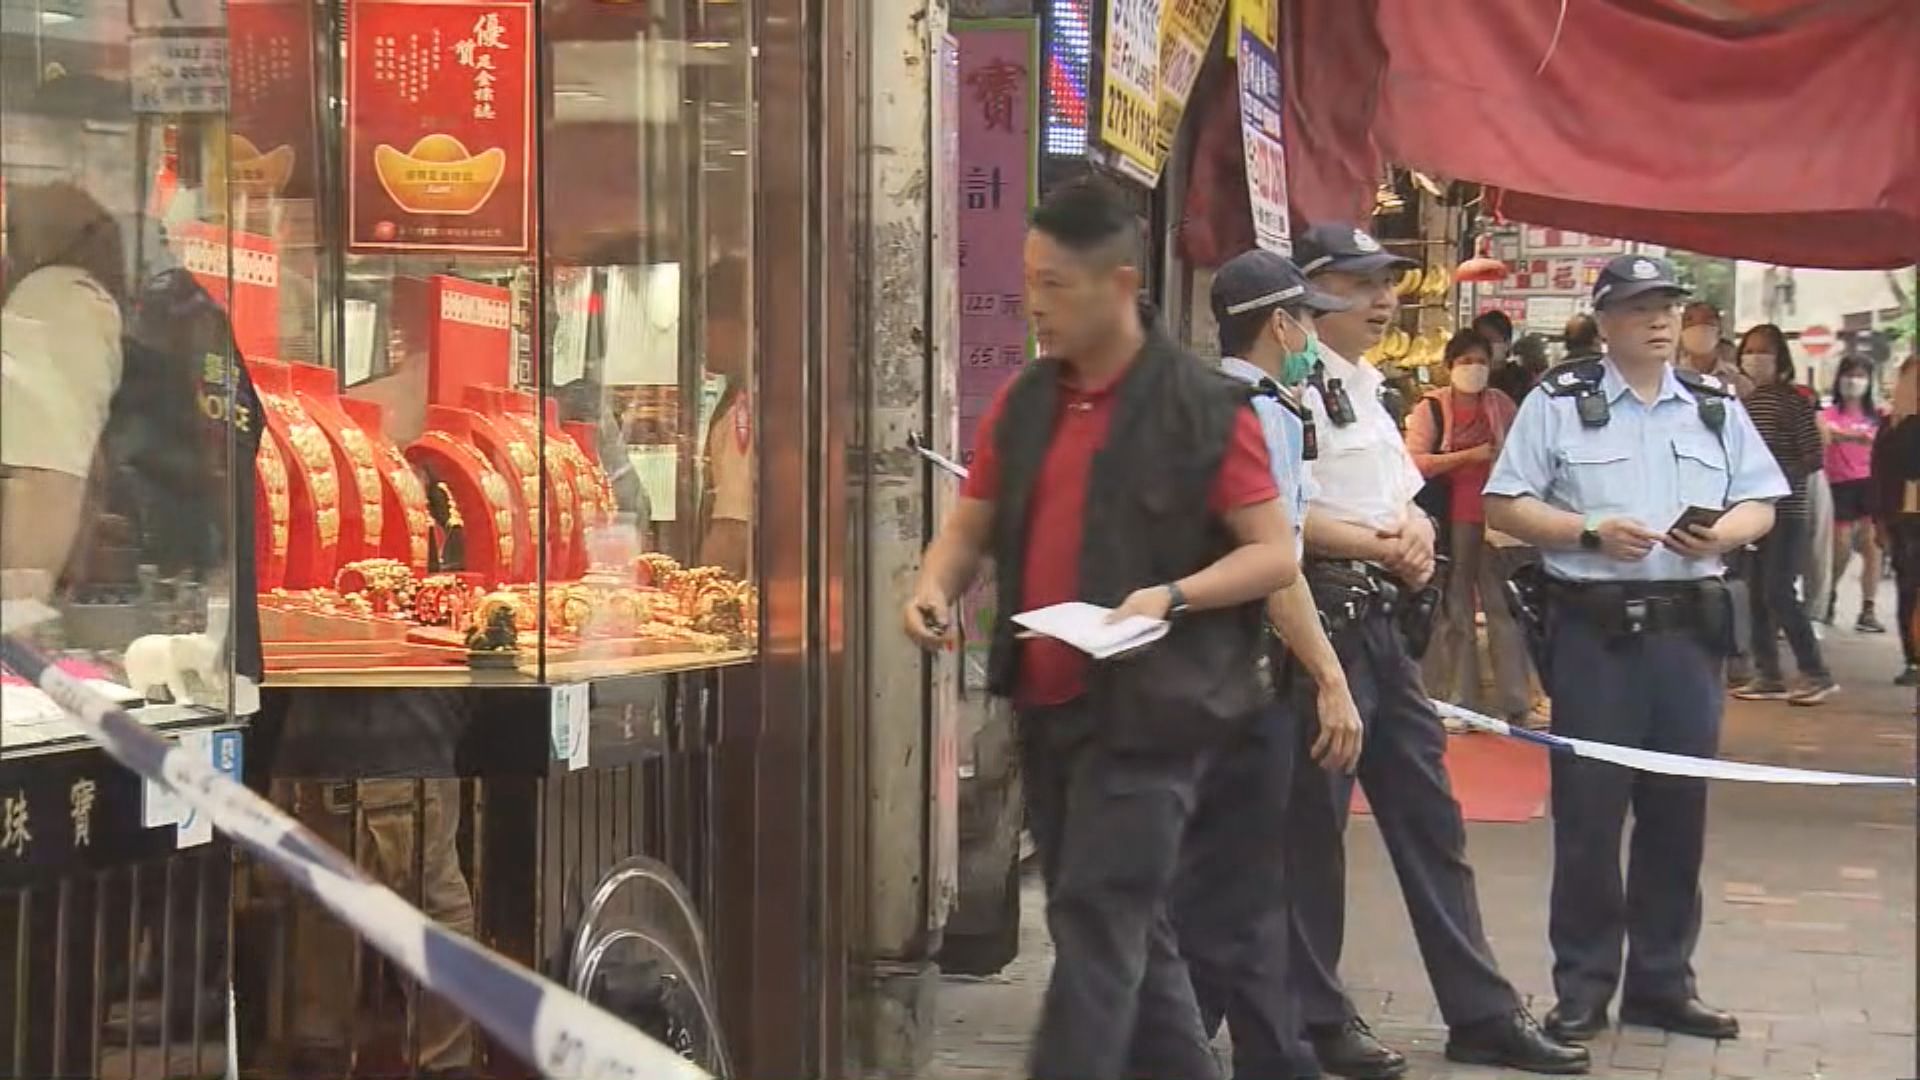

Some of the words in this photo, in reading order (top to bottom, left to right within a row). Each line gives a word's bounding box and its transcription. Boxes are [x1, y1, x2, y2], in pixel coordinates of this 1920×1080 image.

[964, 57, 1027, 133] 寶
[959, 166, 1008, 209] 計
[965, 296, 995, 313] 120
[1000, 294, 1025, 317] 元
[970, 347, 995, 367] 65
[1001, 344, 1024, 367] 元
[1, 777, 98, 858] 珠寶
